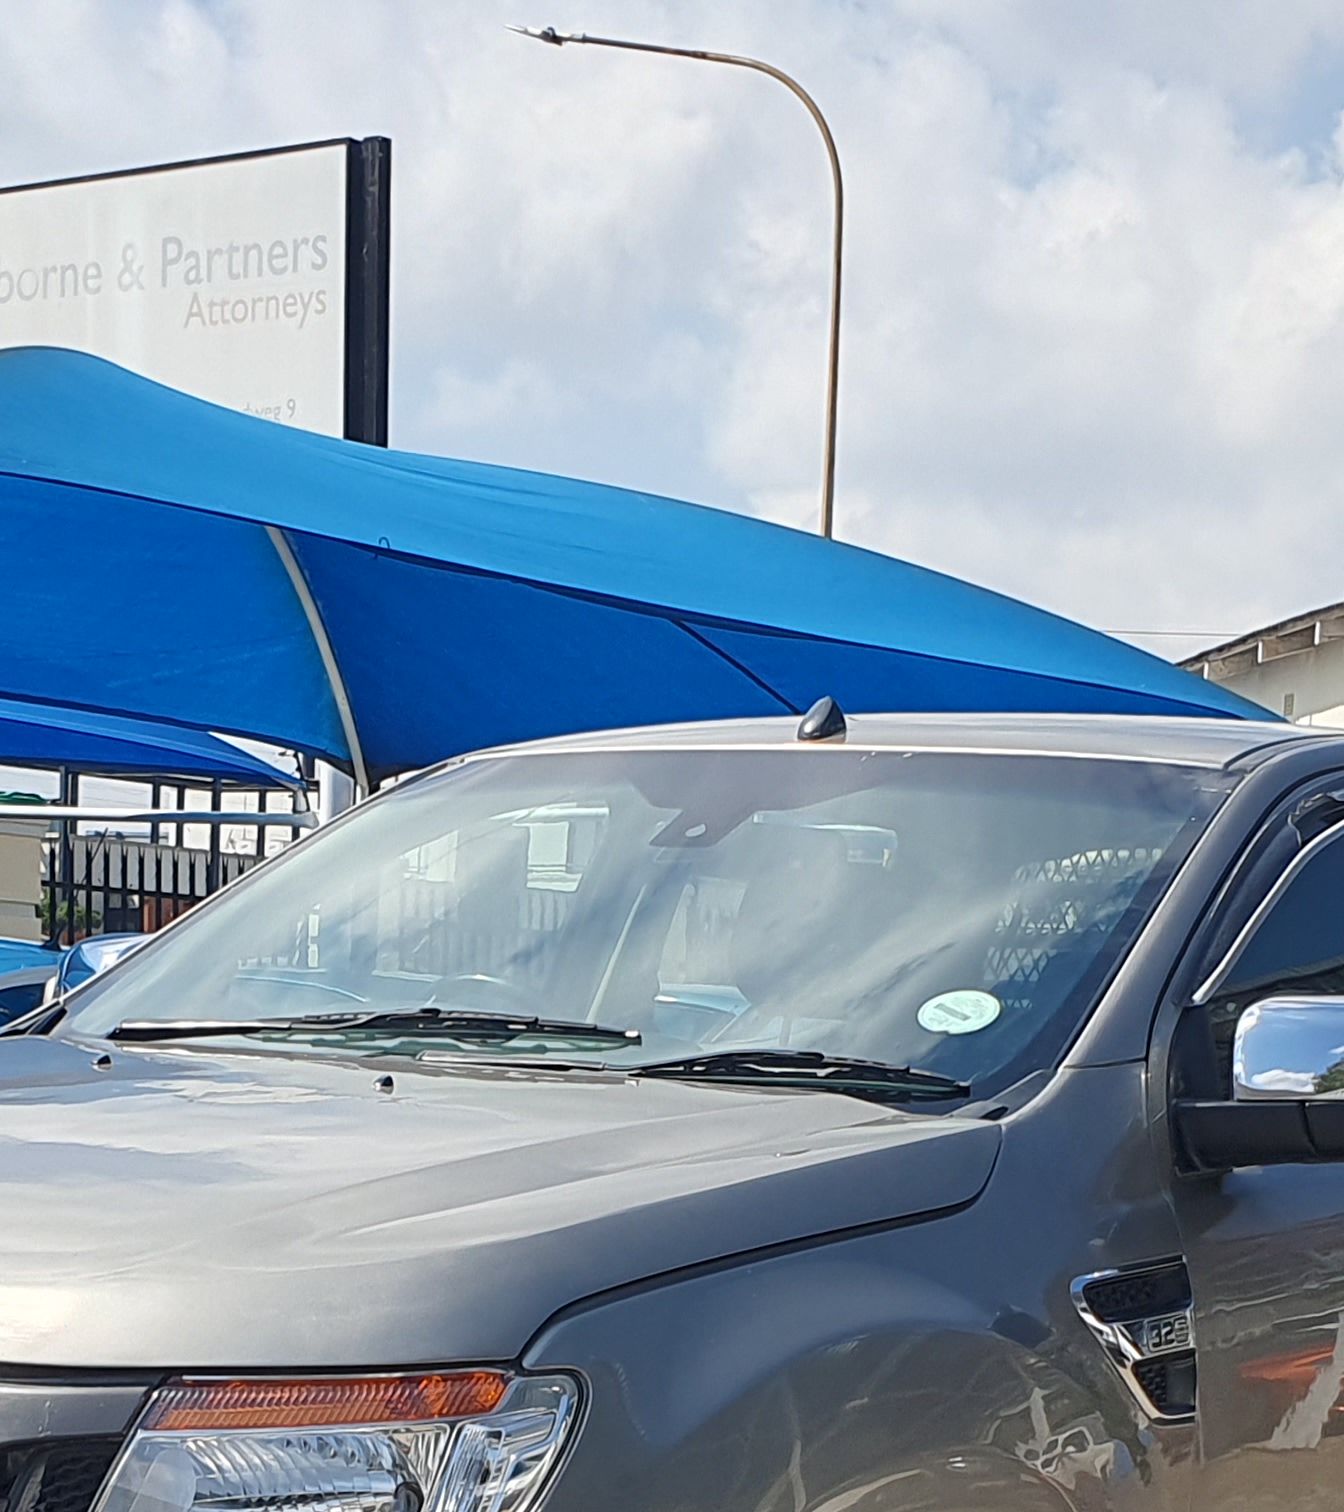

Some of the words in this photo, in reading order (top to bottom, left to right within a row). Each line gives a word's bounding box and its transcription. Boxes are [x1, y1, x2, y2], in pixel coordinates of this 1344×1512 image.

[117, 242, 146, 293] &
[160, 233, 329, 288] Partners
[182, 289, 328, 330] Attorneys
[286, 398, 296, 419] 9
